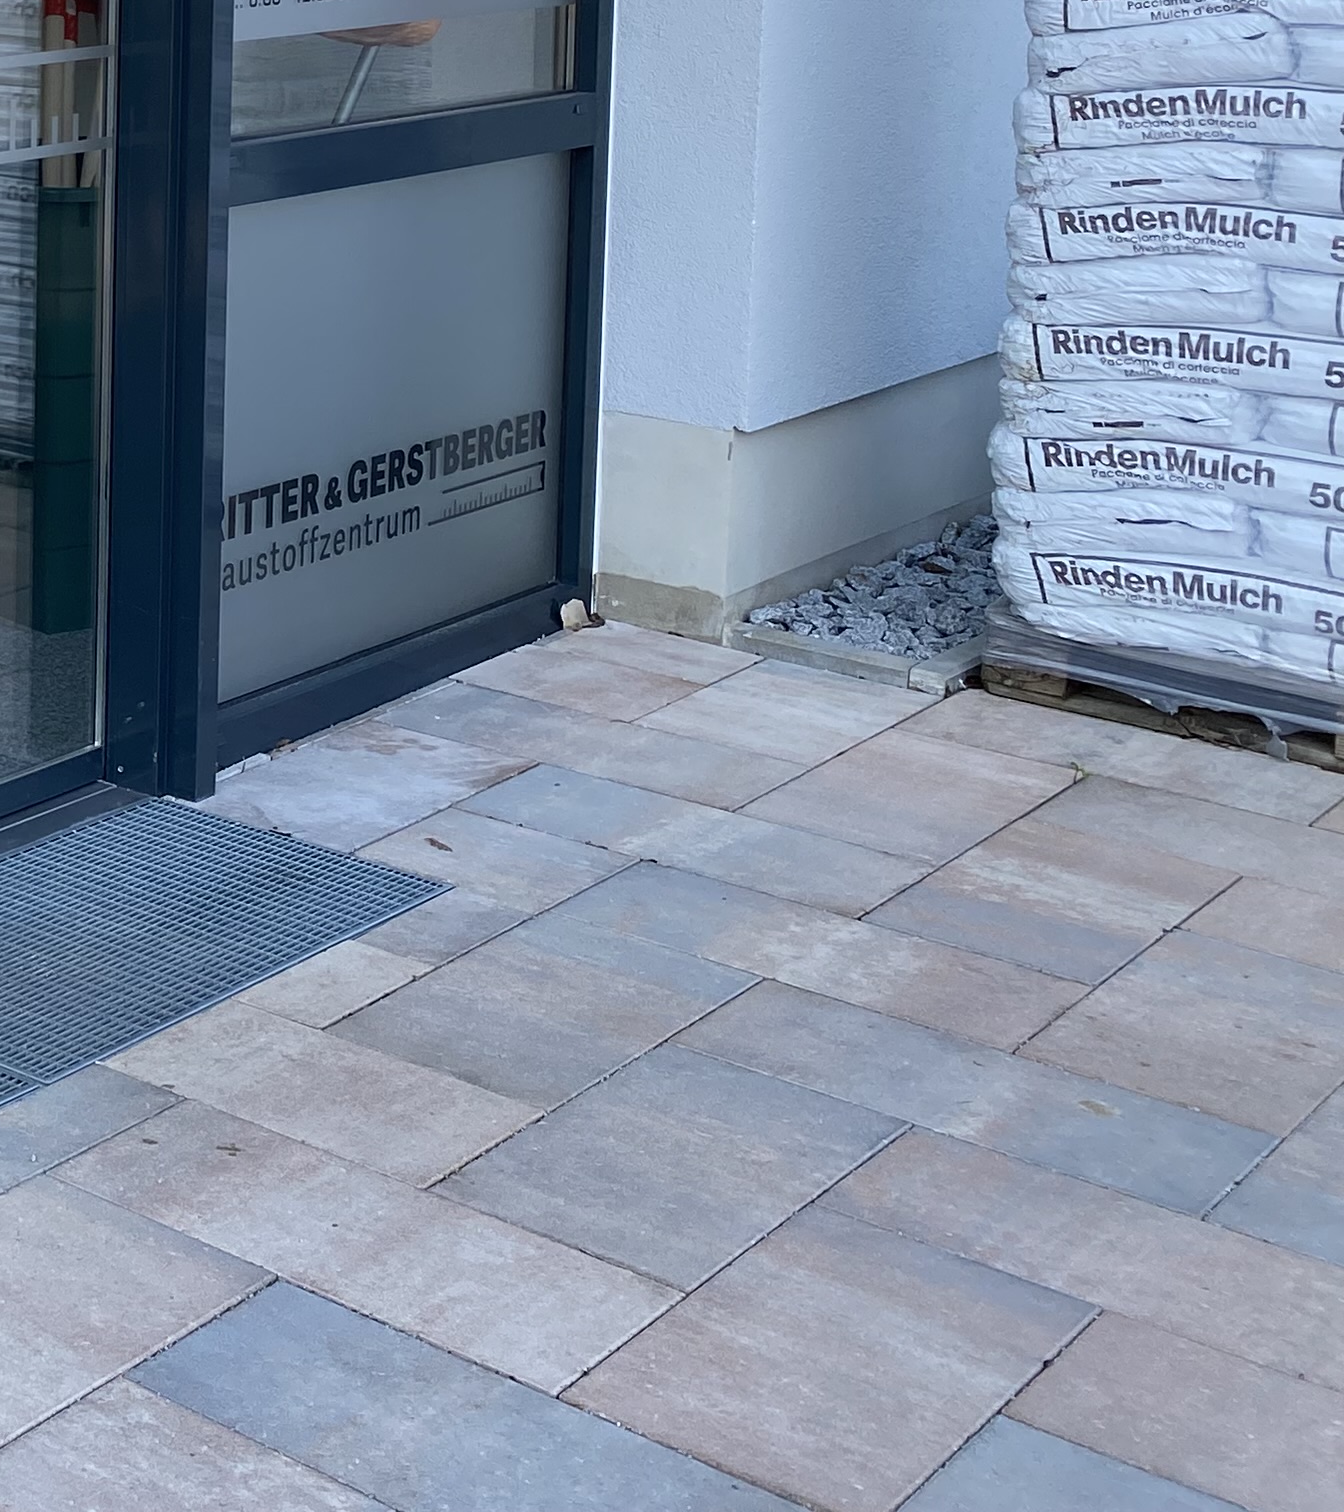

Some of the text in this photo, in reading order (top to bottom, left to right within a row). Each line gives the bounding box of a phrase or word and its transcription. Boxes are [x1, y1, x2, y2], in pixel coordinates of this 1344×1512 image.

[1150, 7, 1190, 21] Mulch
[324, 476, 342, 510] &
[347, 410, 546, 503] GERSTBERGER
[221, 504, 421, 592] austoffzentrum
